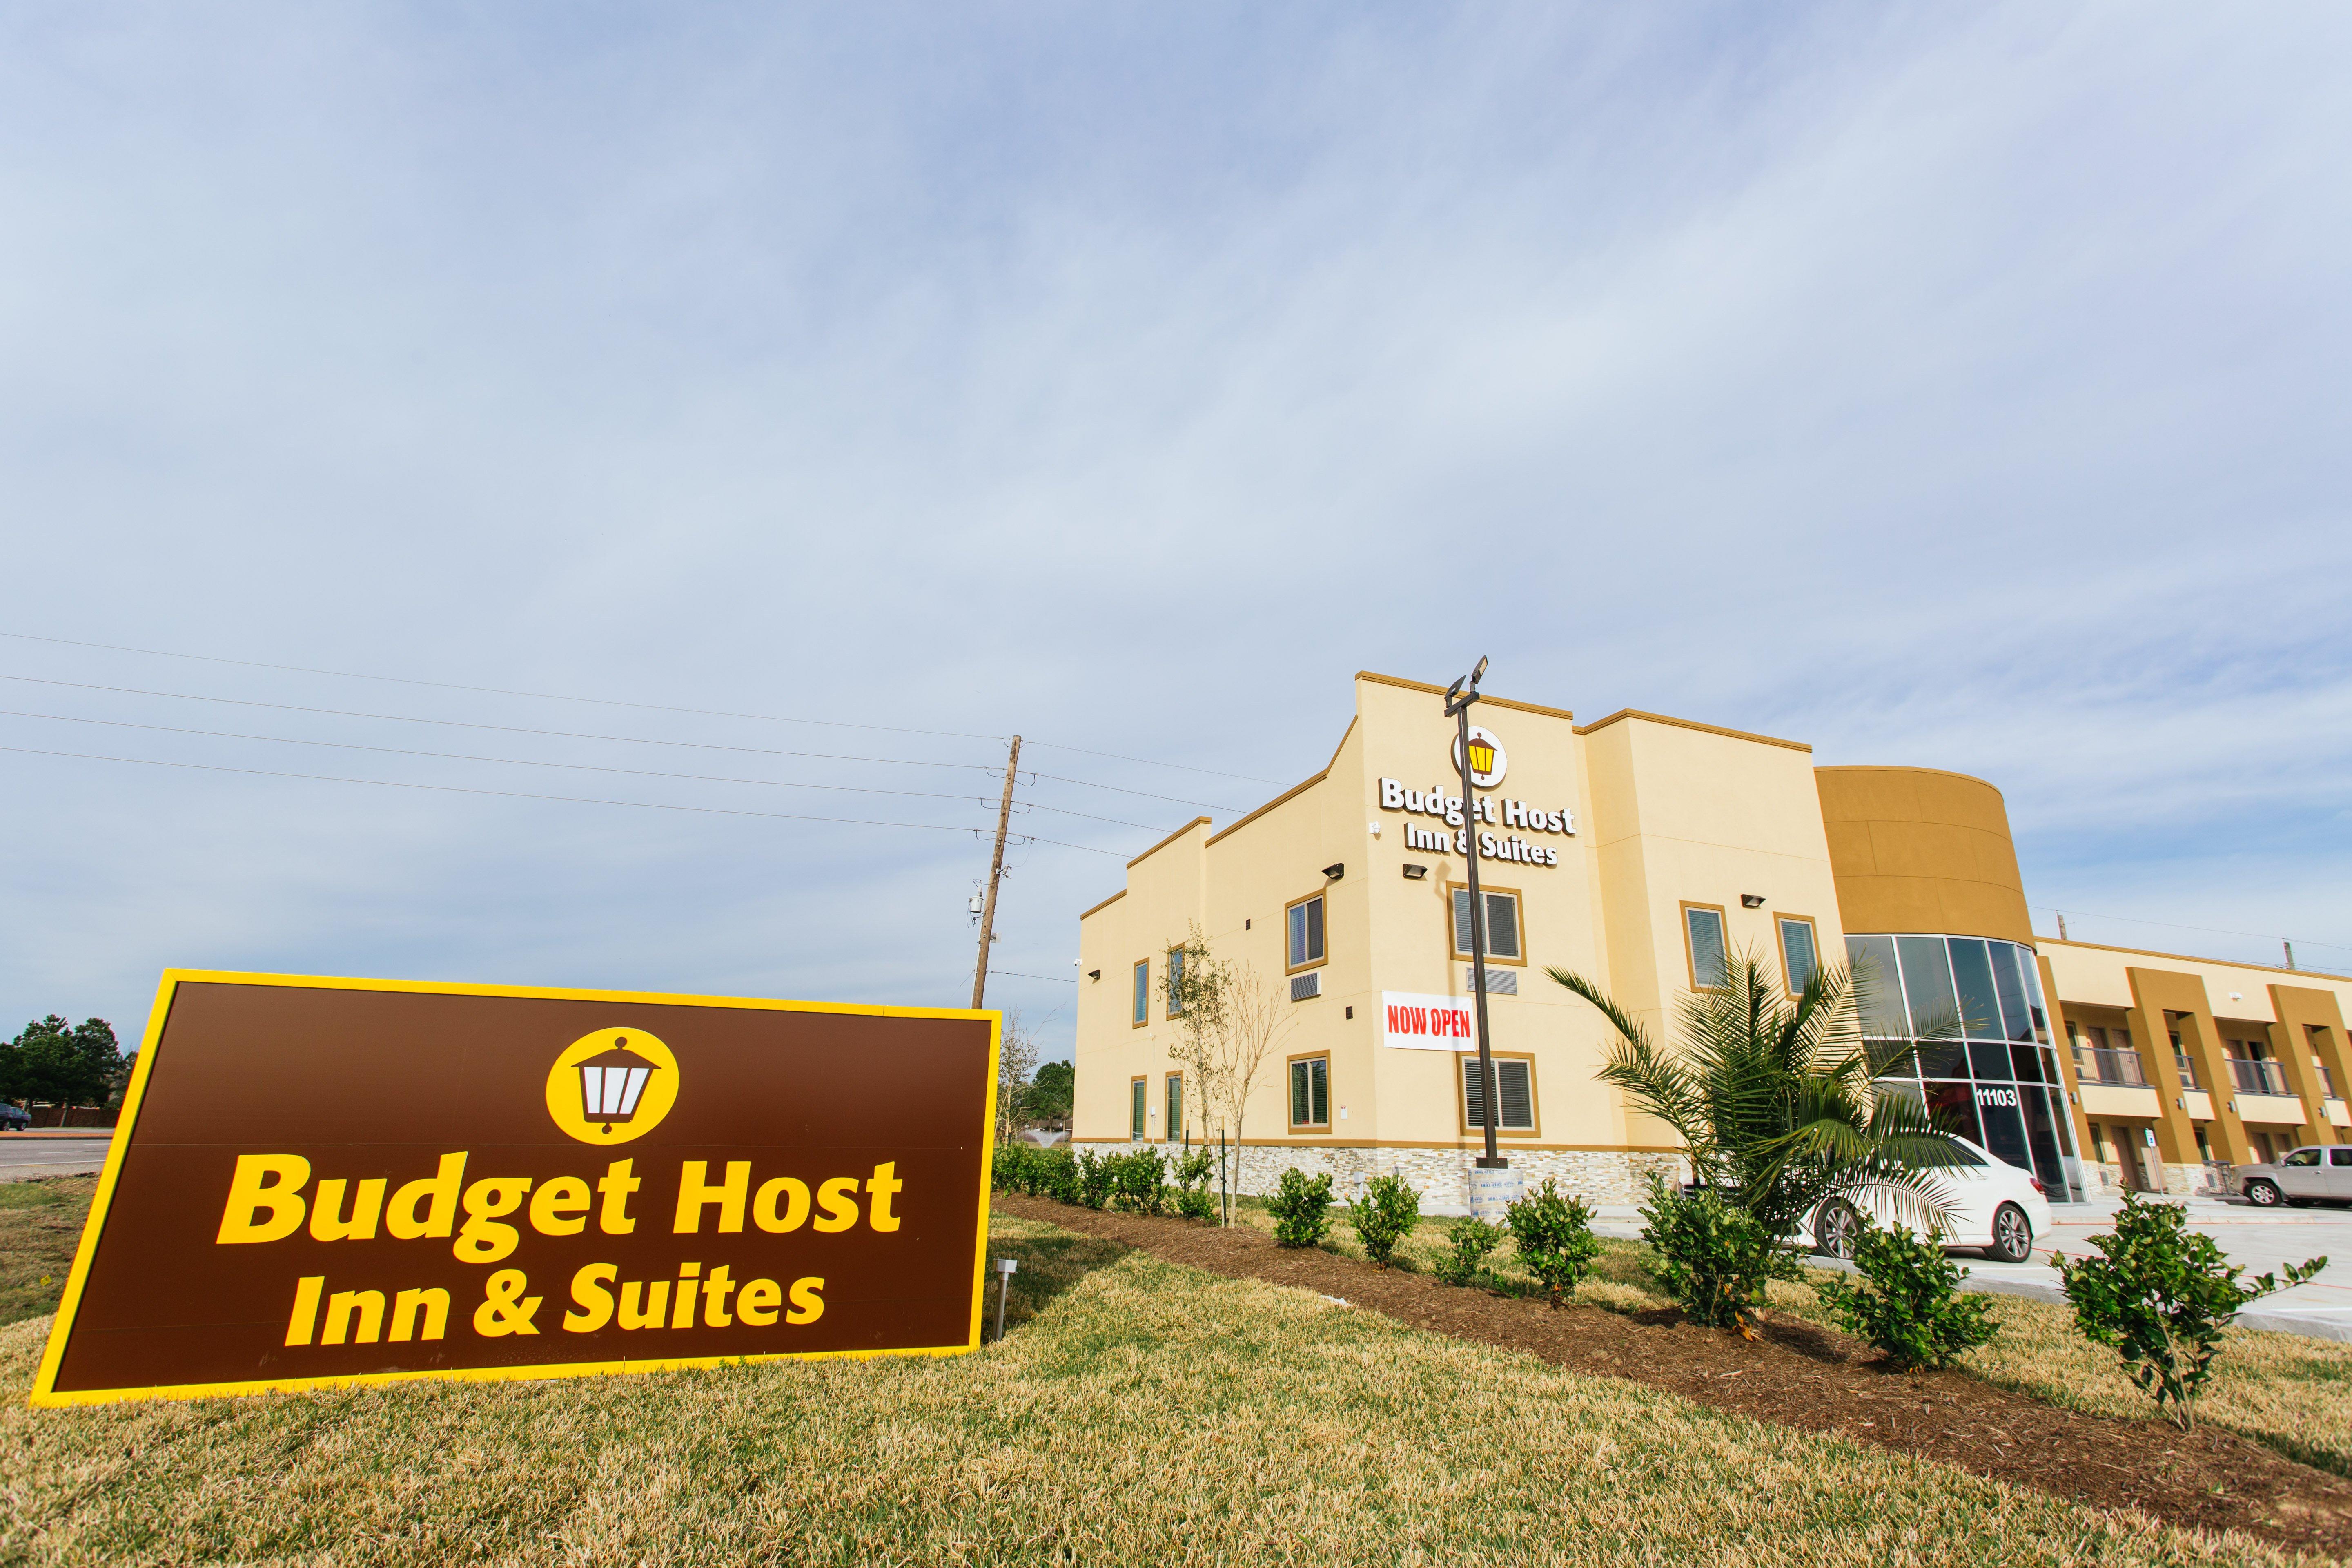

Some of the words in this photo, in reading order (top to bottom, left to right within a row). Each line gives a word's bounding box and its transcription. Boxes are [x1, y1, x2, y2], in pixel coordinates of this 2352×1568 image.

[1379, 777, 1497, 826] Budget
[1501, 798, 1577, 835] Host
[1404, 822, 1450, 852] Inn
[1478, 831, 1558, 866] Suites
[1388, 1005, 1427, 1035] NOW
[1430, 1008, 1470, 1038] OPEN
[1976, 1089, 2017, 1106] 11103
[216, 1151, 641, 1263] Budget
[673, 1160, 903, 1234] Host
[285, 1276, 450, 1346] Inn
[474, 1269, 543, 1337] &
[563, 1262, 824, 1333] Suites
